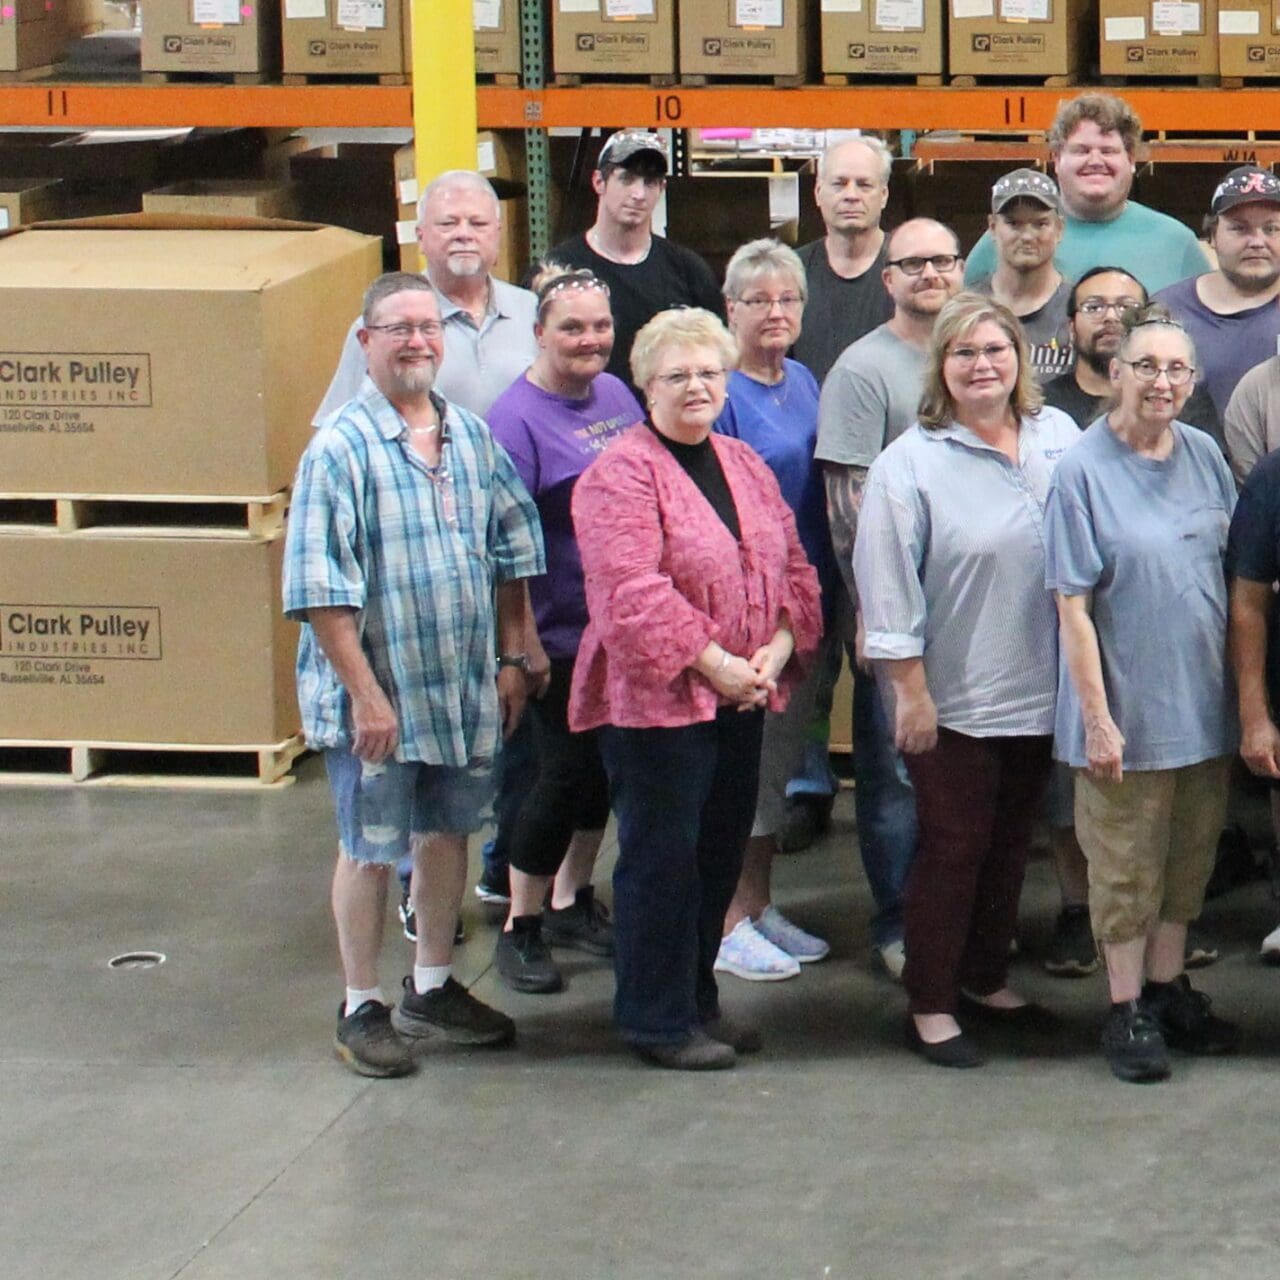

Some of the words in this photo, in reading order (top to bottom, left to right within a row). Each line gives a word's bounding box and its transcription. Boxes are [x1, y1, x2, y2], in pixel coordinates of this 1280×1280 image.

[655, 95, 682, 121] 10
[0, 361, 61, 383] Clark
[69, 361, 140, 389] Pulley
[5, 390, 98, 401] NDUSTRIES
[108, 390, 138, 401] INC
[23, 410, 50, 420] Clark
[53, 410, 81, 420] Drive
[8, 613, 72, 636] Clark
[80, 614, 149, 641] Pulley
[9, 642, 108, 654] INDUSTRIES
[119, 643, 149, 655] INC
[34, 662, 61, 672] Clark
[64, 662, 91, 672] Drive
